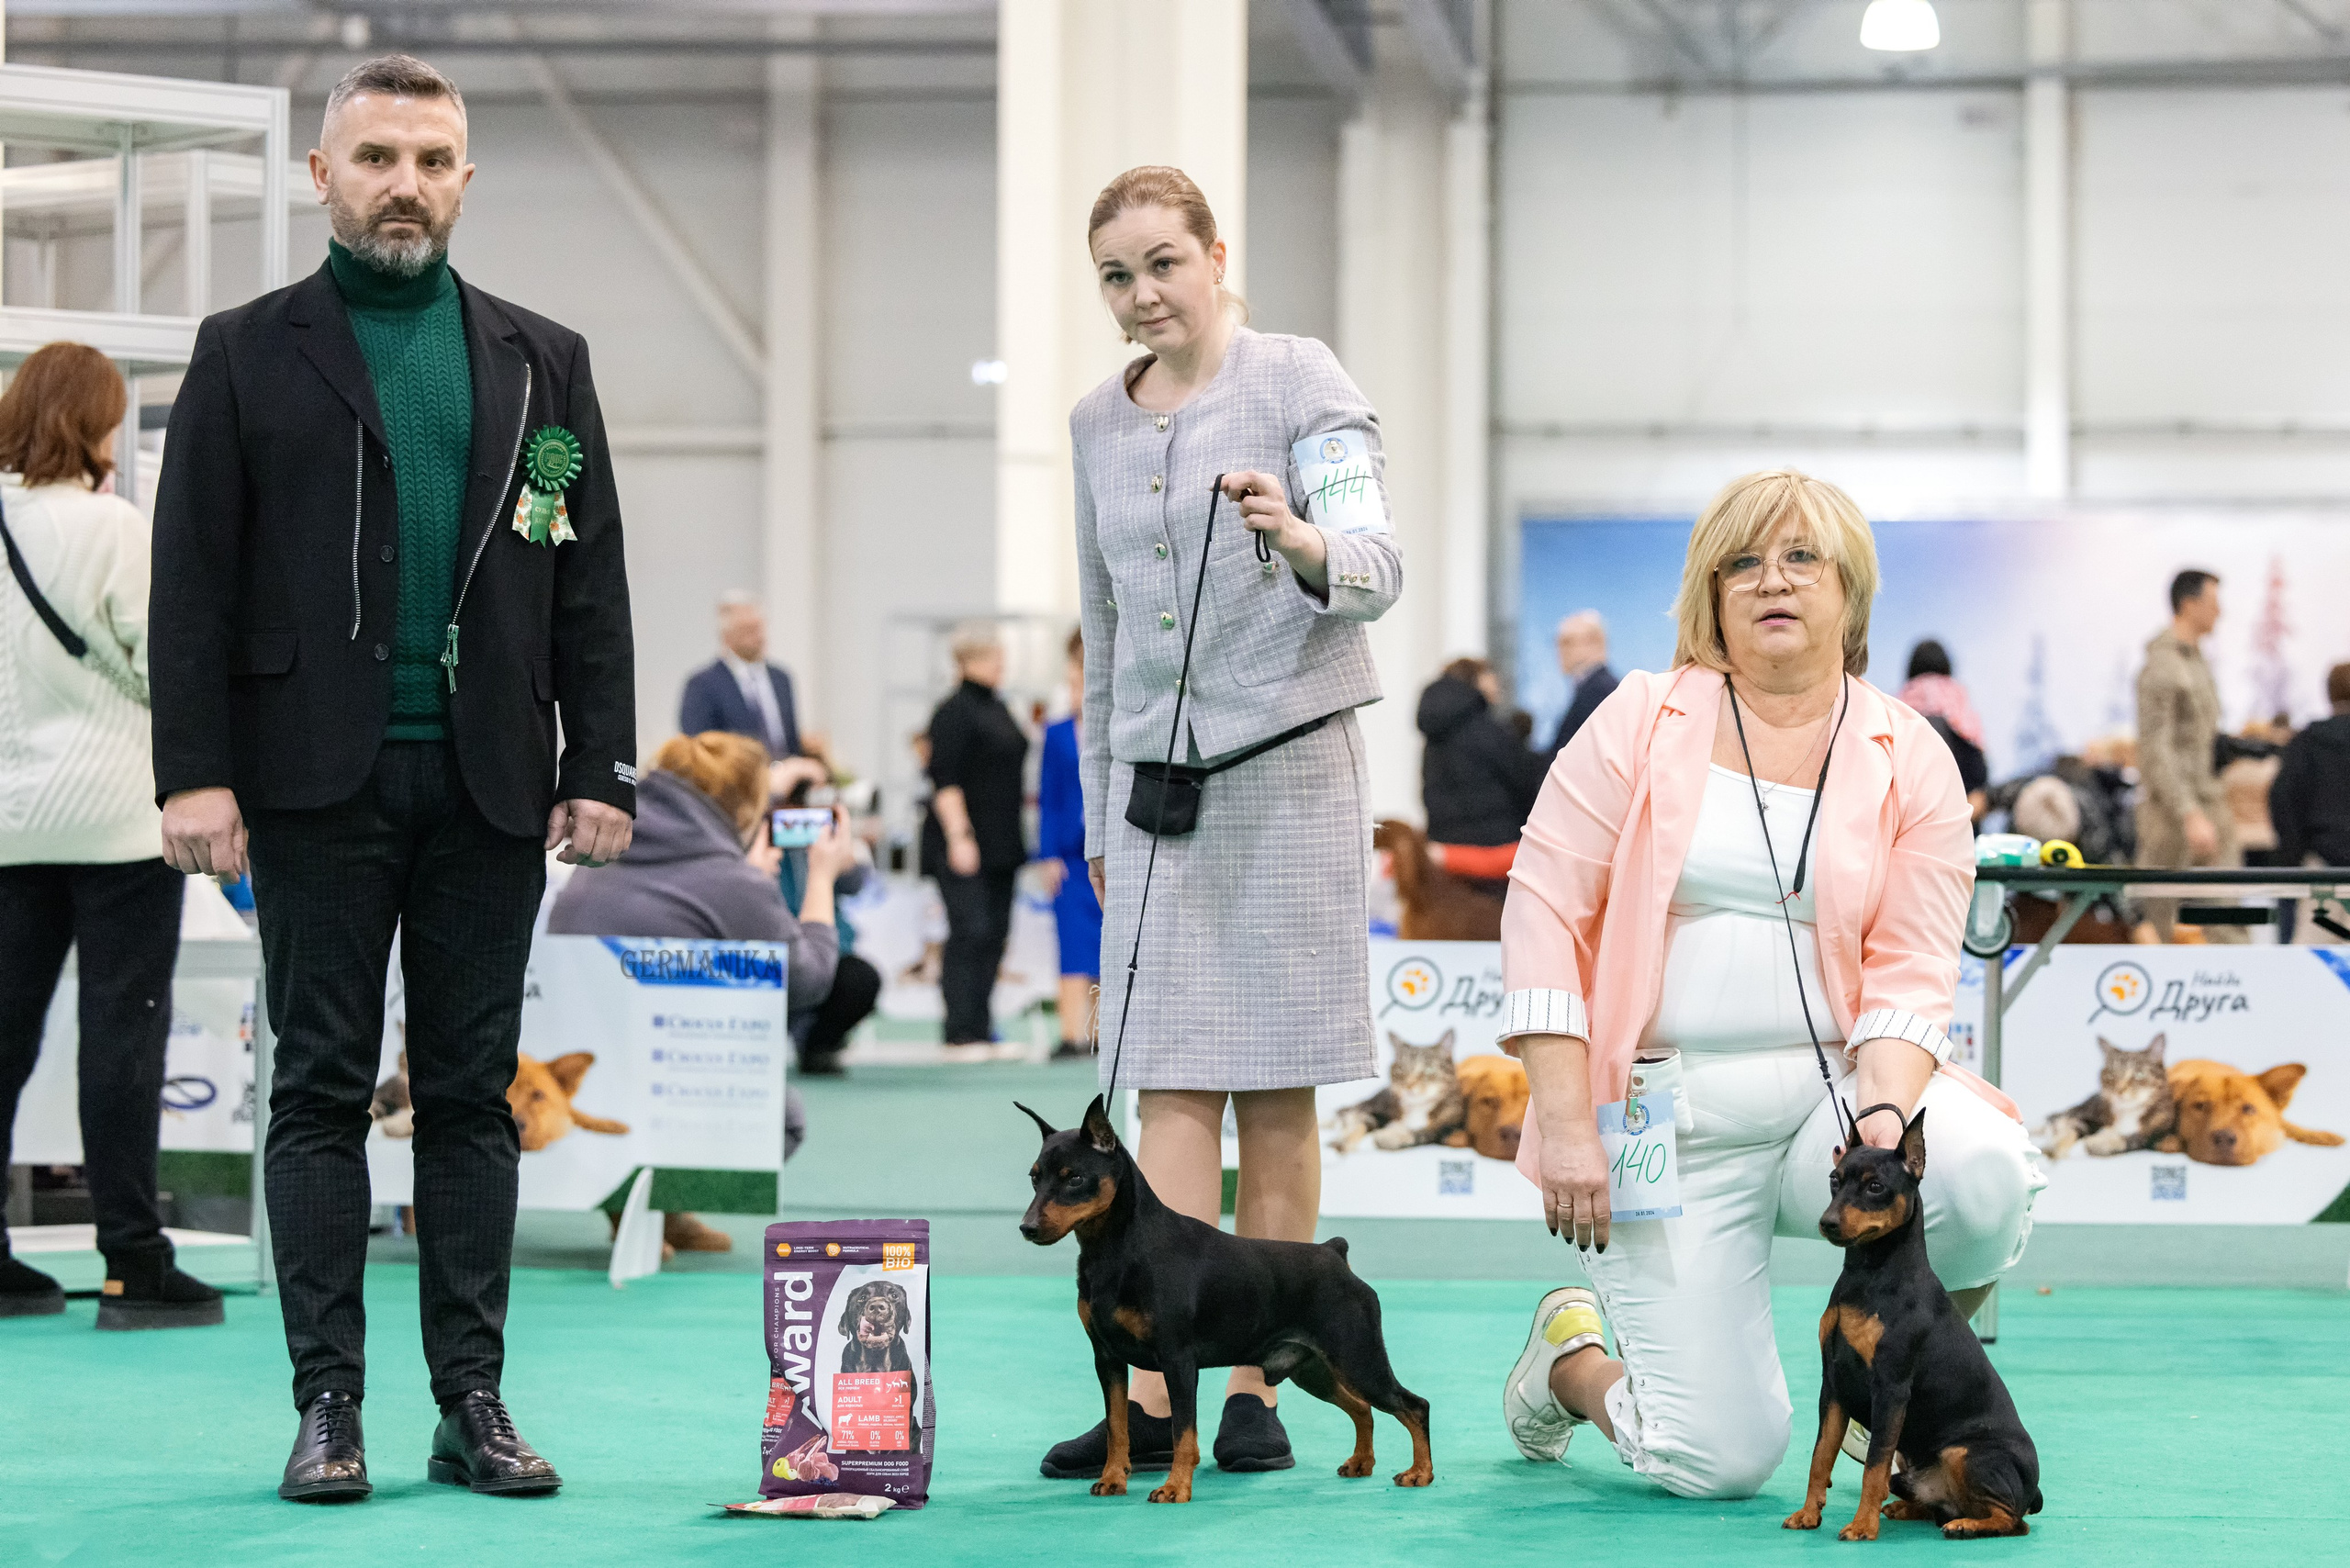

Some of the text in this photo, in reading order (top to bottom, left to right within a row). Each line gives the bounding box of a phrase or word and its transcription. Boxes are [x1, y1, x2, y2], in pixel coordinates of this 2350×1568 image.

[1317, 465, 1366, 513] 144
[614, 760, 637, 779] DSQUAR
[1439, 974, 1505, 1018] Дру
[2149, 979, 2250, 1023] Друга
[1612, 1138, 1666, 1189] 140
[885, 1245, 912, 1258] 100%
[885, 1257, 911, 1269] BIO
[837, 1395, 862, 1404] ADULT
[841, 1430, 855, 1440] 71%
[870, 1430, 880, 1440] 0%
[895, 1430, 904, 1440] 0%
[884, 1483, 891, 1492] 2
